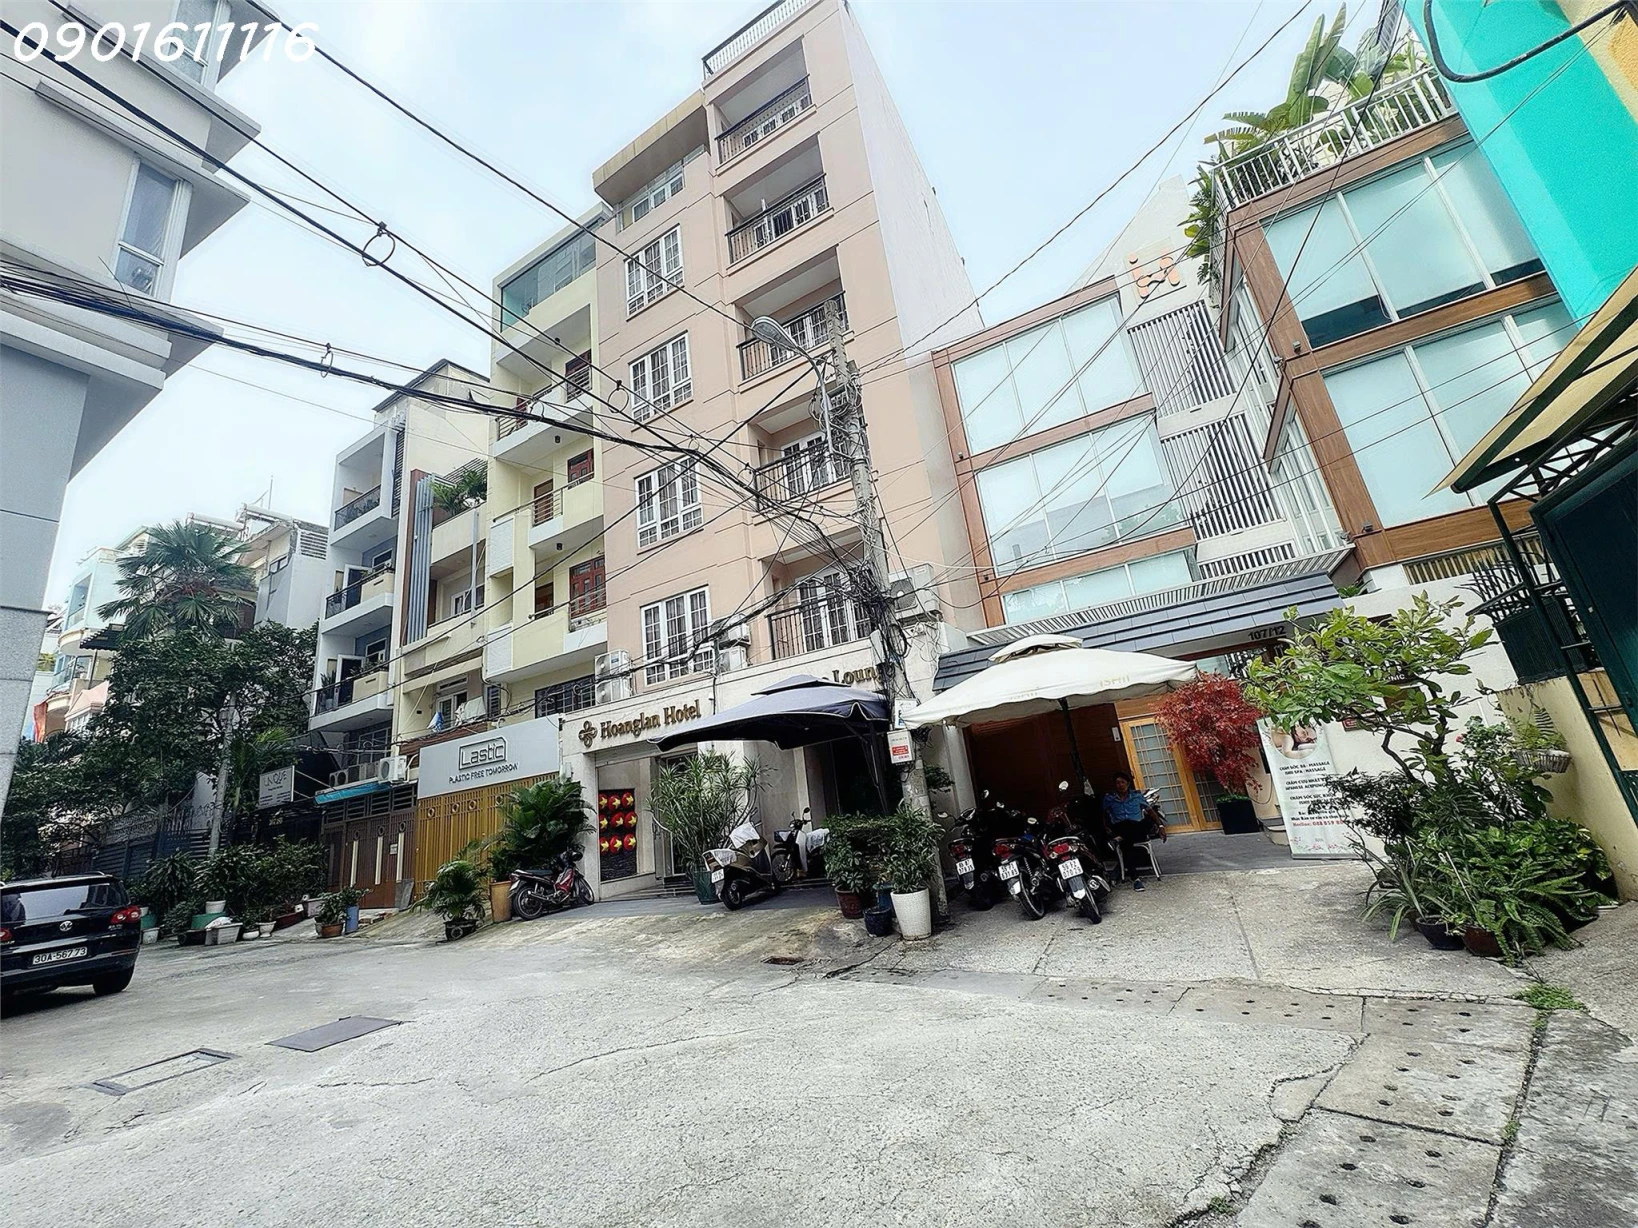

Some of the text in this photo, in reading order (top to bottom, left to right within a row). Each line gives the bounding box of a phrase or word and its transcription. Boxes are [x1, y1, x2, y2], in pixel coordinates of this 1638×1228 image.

[1247, 625, 1287, 641] 107/12
[832, 666, 882, 685] Loung
[600, 699, 702, 739] Hoanglan Hotel
[448, 762, 519, 785] PLASTIC FREE TOMORROW
